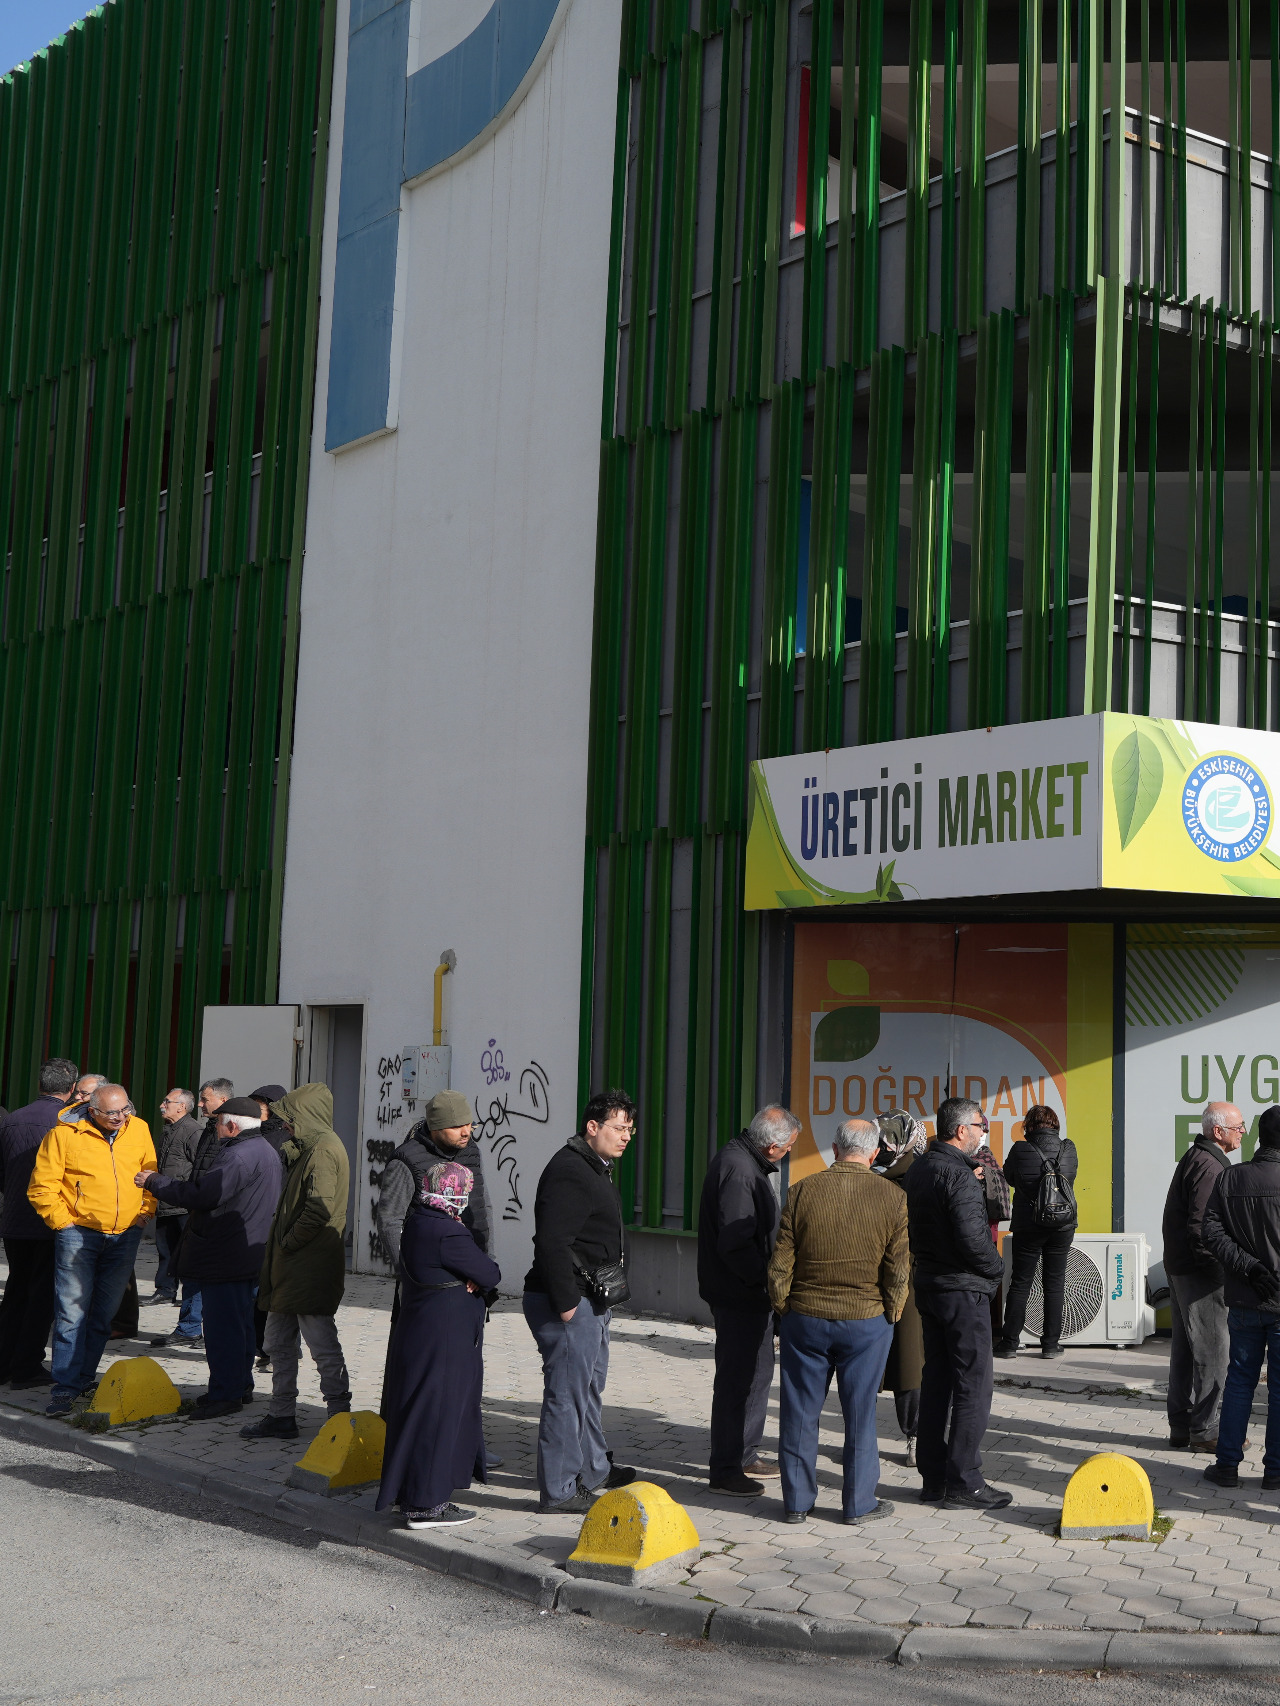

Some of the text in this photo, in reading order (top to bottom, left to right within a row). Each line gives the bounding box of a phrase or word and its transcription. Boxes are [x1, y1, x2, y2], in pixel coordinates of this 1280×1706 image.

[1197, 758, 1255, 785] ESKİŞEHİR
[801, 761, 1089, 861] ÜRETİCİ MARKET
[1184, 788, 1268, 859] BÜYÜKŞEHİR BELEDİYESİ
[812, 1066, 1045, 1117] DOĞRUDAN
[1114, 1253, 1124, 1297] baymak
